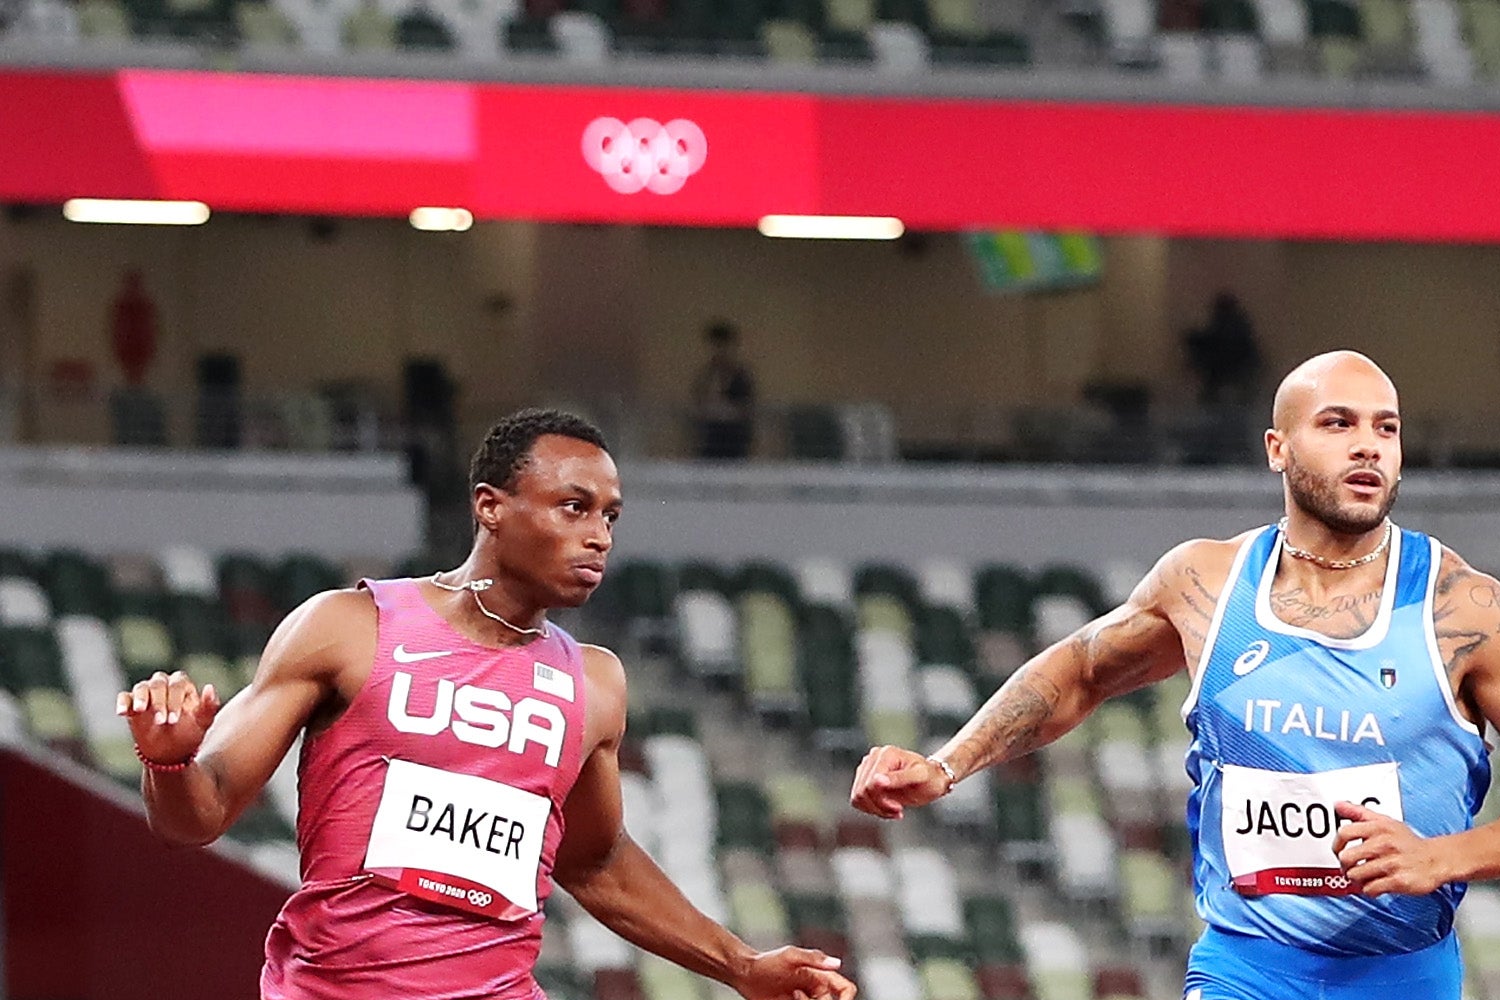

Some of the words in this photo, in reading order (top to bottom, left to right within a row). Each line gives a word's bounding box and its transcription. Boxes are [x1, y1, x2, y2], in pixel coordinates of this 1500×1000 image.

[387, 671, 566, 767] USA
[1244, 699, 1385, 746] ITALIA
[406, 795, 525, 860] BAKER
[1236, 796, 1381, 839] JACO
